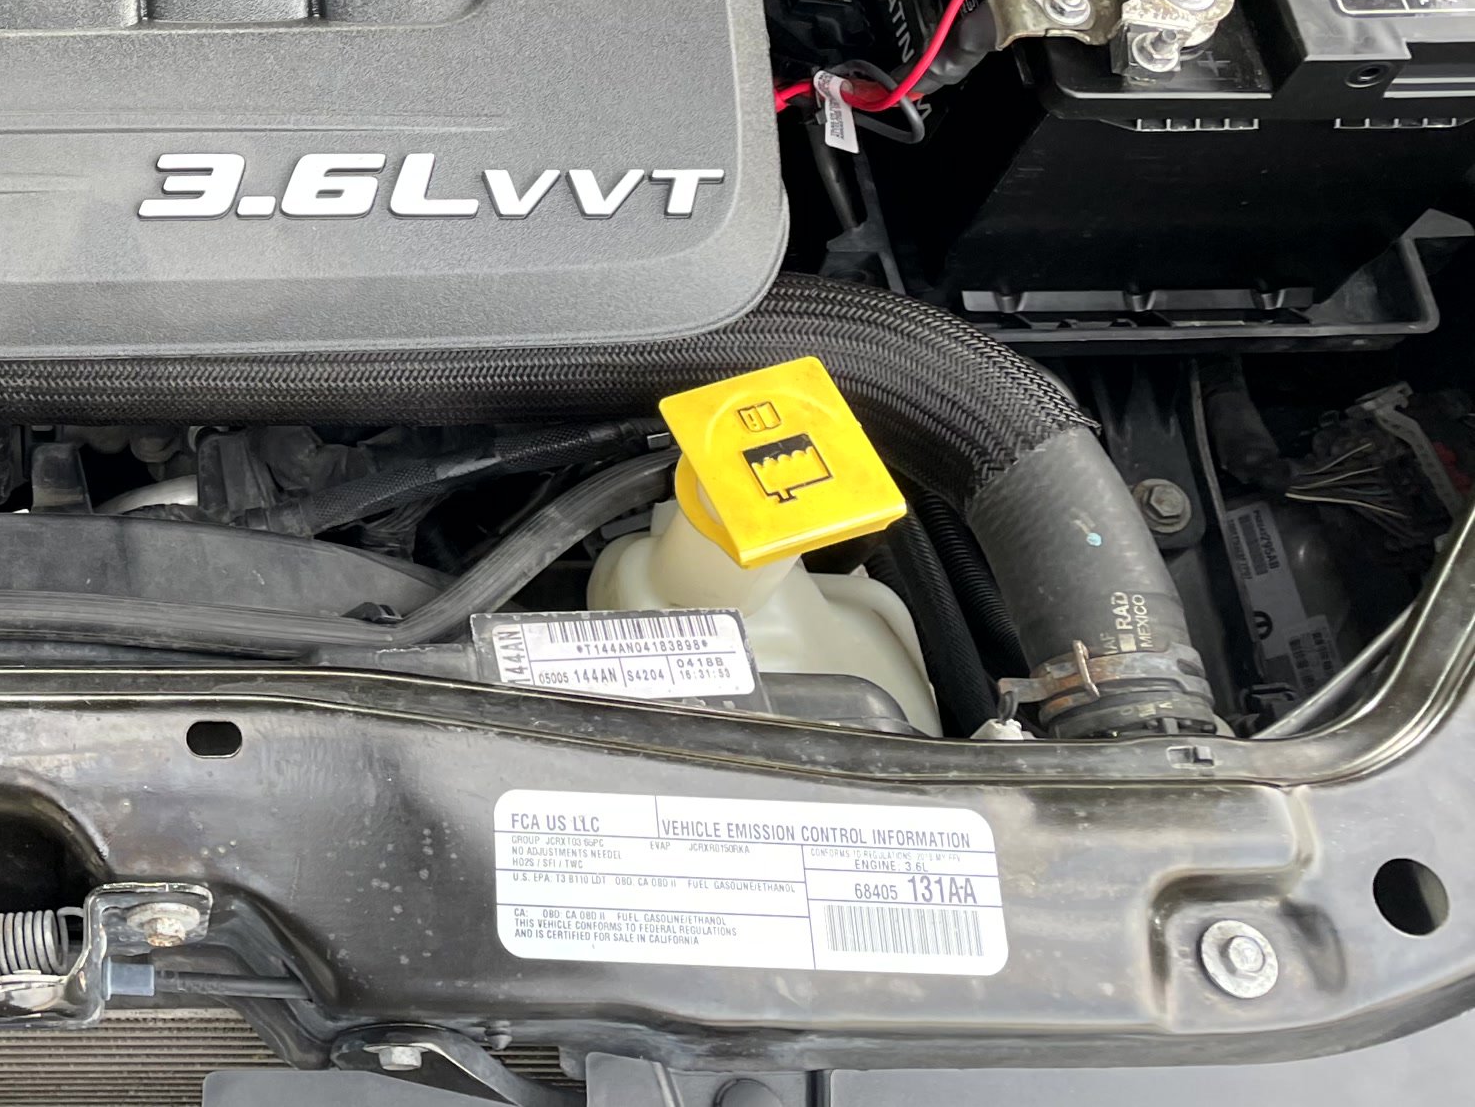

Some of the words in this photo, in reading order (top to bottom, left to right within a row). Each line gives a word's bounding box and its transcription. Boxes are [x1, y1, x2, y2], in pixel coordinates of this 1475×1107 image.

[1111, 591, 1134, 630] RAD
[1132, 594, 1154, 649] MEXICO
[538, 672, 570, 685] 05005
[574, 667, 618, 683] 144AN
[627, 669, 665, 682] S4204
[679, 667, 732, 680] 16:31:53
[512, 813, 540, 831] FCA
[546, 815, 566, 831] US
[573, 815, 600, 833] LLC
[662, 819, 721, 838] VEHICLE
[727, 823, 795, 841] EMISSION
[801, 825, 867, 845] CONTROL
[872, 829, 970, 849] INFORMATION
[512, 846, 524, 856] NO
[527, 847, 588, 858] ADJUSTMENTS
[565, 859, 584, 869] TWC
[854, 883, 898, 901] 68405
[907, 875, 978, 904] 131AA
[515, 918, 534, 927] THIS
[538, 919, 572, 930] VEHICLE
[575, 921, 622, 932] CONFORMS
[626, 923, 637, 933] TO
[639, 923, 676, 935] FEDERAL
[679, 925, 737, 937] REGULATIONS
[515, 929, 532, 939] AND
[535, 929, 544, 939] IS
[545, 930, 591, 941] CERTIFIED
[594, 931, 610, 941] FOR
[614, 933, 634, 943] SALE
[637, 933, 646, 943] IN
[649, 933, 700, 946] CALIFORNIA
